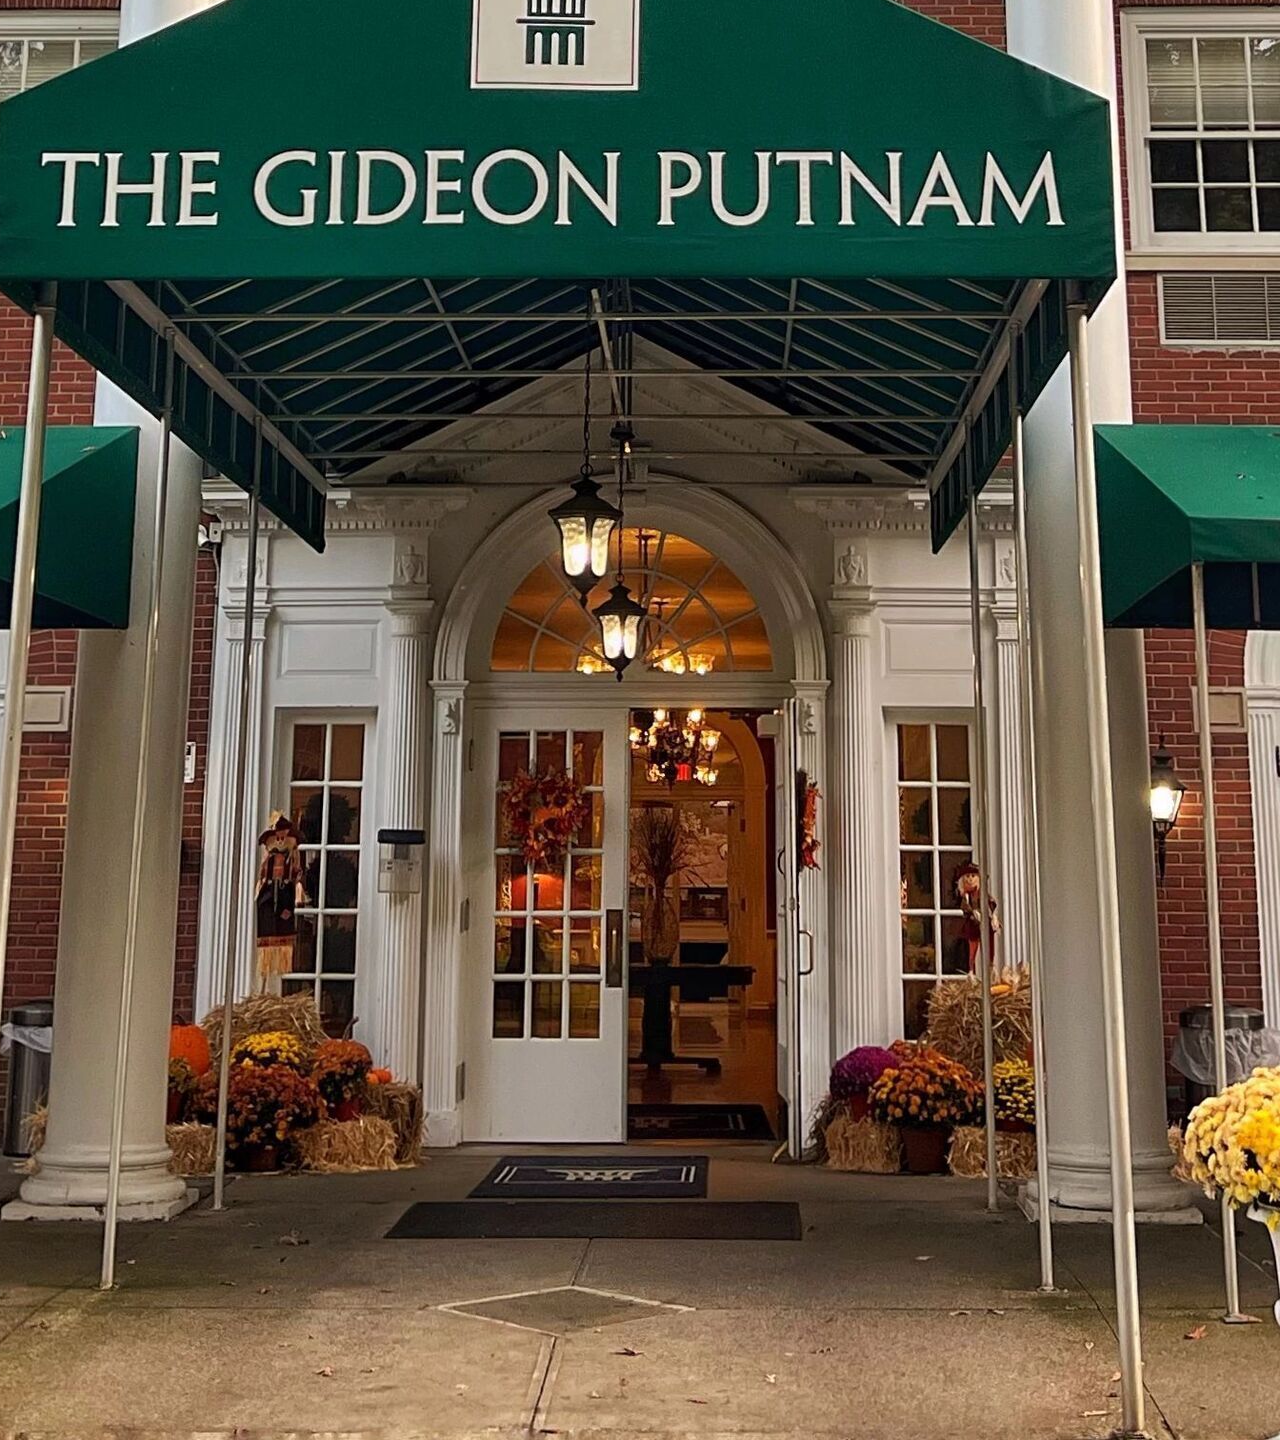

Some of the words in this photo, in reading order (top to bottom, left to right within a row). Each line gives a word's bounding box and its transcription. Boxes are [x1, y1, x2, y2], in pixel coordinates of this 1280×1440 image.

[40, 150, 220, 227] THE
[253, 149, 621, 227] GIDEON
[655, 150, 1066, 227] PUTNAM
